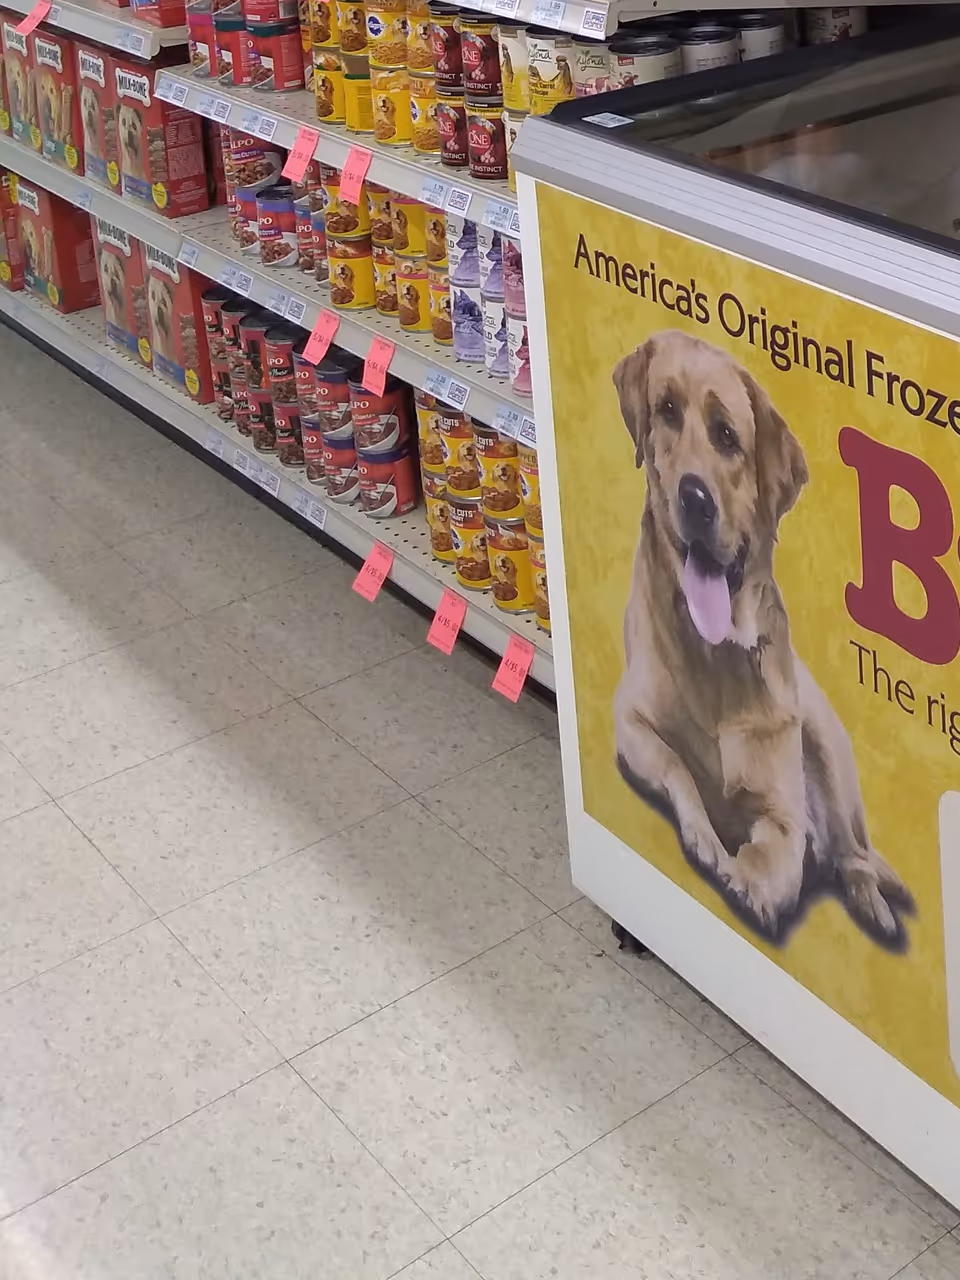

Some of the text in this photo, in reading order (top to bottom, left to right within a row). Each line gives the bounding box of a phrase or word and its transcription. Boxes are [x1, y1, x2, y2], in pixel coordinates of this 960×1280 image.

[117, 74, 148, 99] MILK-BONE
[469, 132, 488, 146] ONE
[573, 233, 710, 325] America's
[718, 293, 855, 389] Original
[849, 639, 916, 715] The
